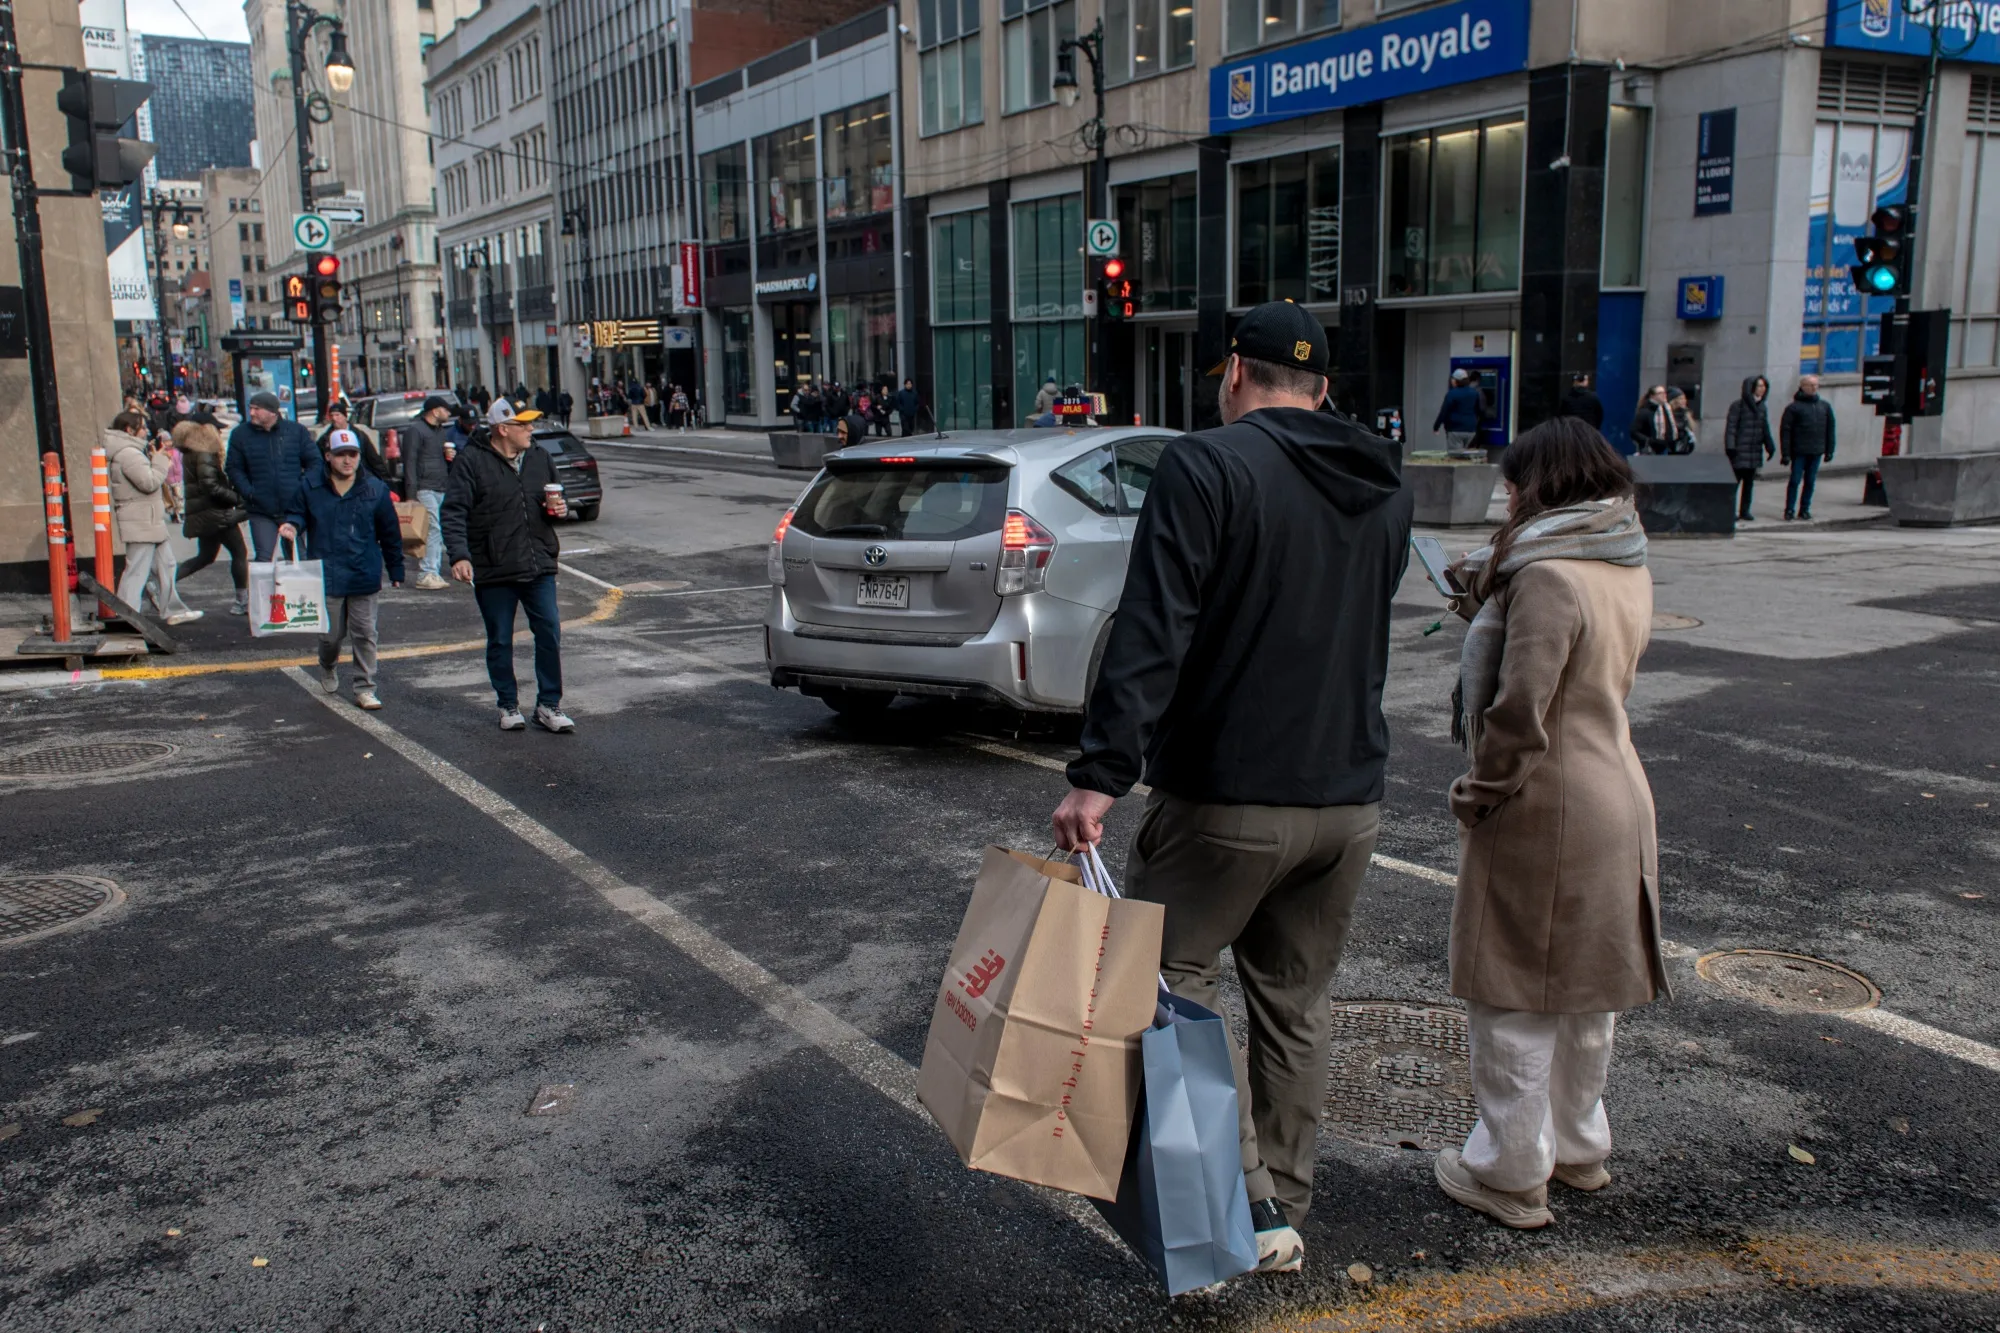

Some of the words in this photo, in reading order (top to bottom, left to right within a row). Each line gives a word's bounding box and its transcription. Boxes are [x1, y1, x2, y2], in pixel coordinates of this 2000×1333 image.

[1865, 16, 1886, 30] RBC
[1270, 48, 1374, 98] Banque
[1381, 12, 1492, 74] Royale
[1231, 102, 1250, 113] RBC
[112, 284, 146, 292] LITTLE
[755, 277, 807, 294] PHARMAPRIX
[1062, 405, 1082, 413] ATLAS
[859, 582, 906, 601] FNR7647
